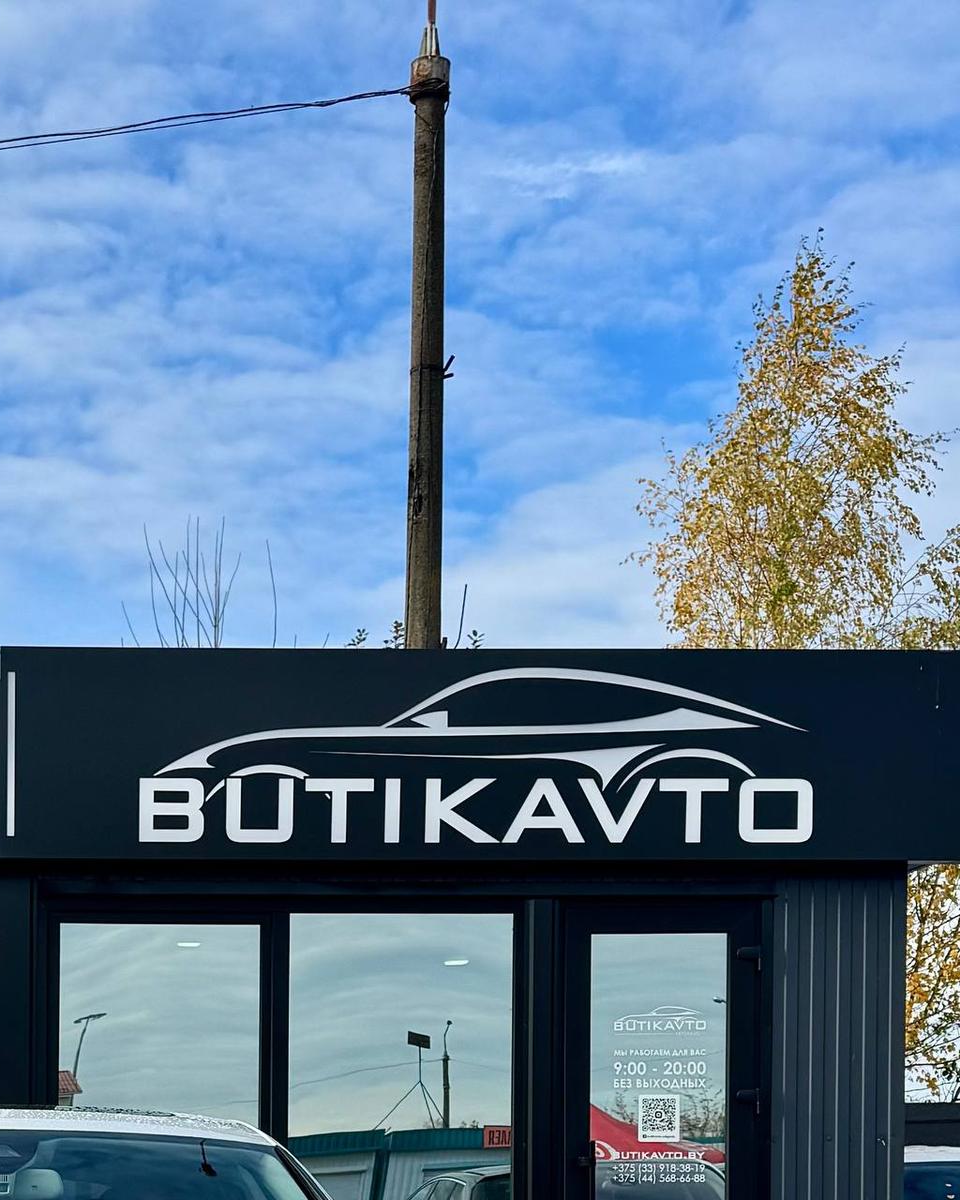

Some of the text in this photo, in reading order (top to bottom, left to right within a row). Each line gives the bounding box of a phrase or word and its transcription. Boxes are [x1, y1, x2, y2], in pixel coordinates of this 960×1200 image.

[139, 777, 814, 844] BUTIKAVTO
[613, 1020, 707, 1031] BUTIKAVTO
[614, 1062, 646, 1075] 9:00
[664, 1062, 706, 1075] 20:00
[613, 1078, 706, 1089] БЕЗ ВЫХОДНЫХ
[613, 1151, 705, 1160] BUTIKAVTO.BY
[612, 1164, 706, 1174] +375 (33) 918-38-19
[612, 1174, 706, 1184] +375 (44) 568-66-88
